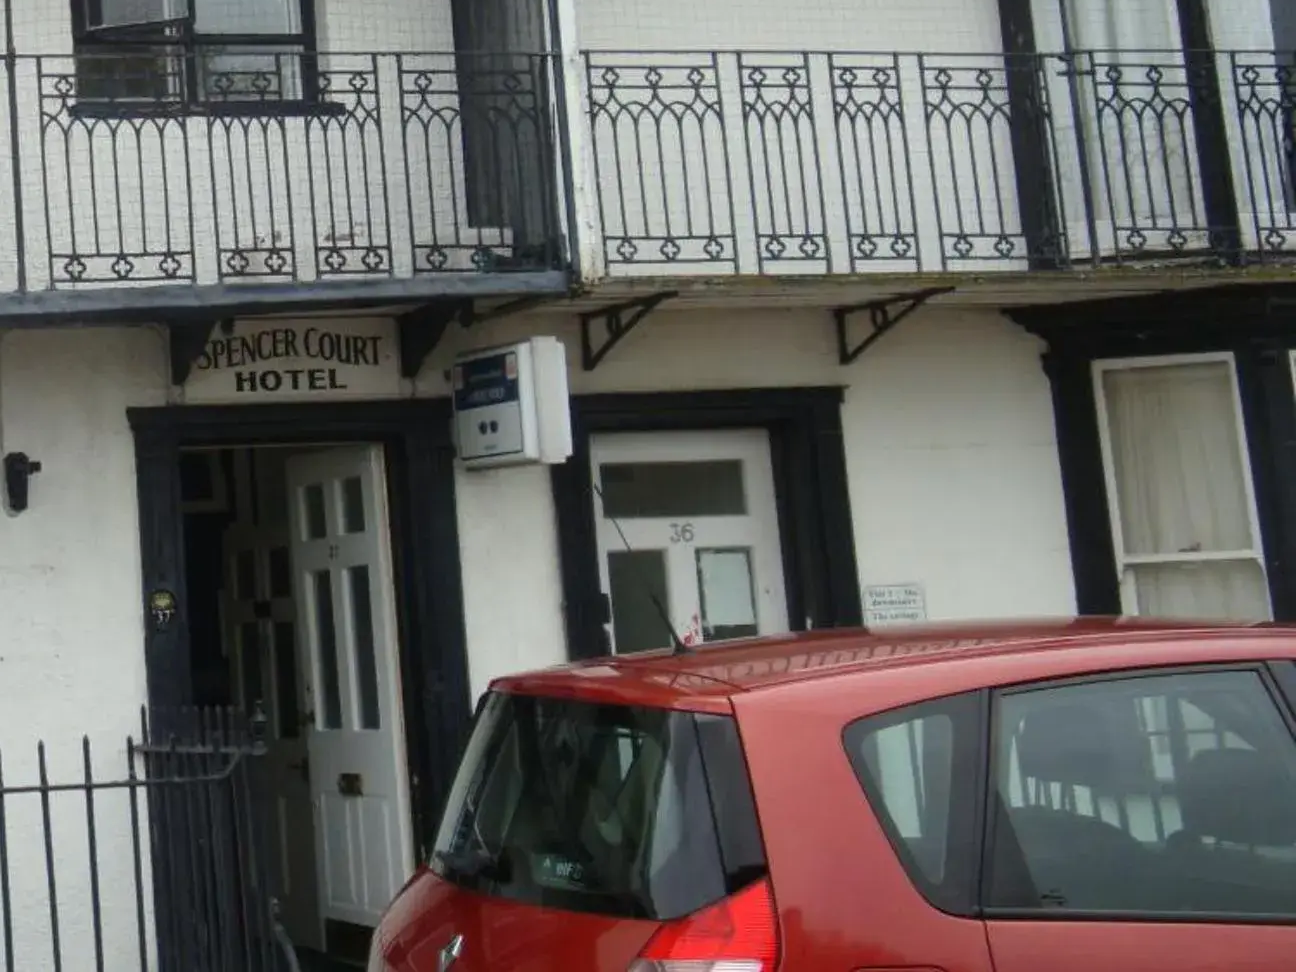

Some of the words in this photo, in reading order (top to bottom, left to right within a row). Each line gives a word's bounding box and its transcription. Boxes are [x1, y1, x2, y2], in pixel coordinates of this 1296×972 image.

[196, 328, 299, 370] SPENCER
[305, 328, 383, 366] COURT
[234, 368, 348, 392] HOTEL
[669, 523, 695, 544] 36
